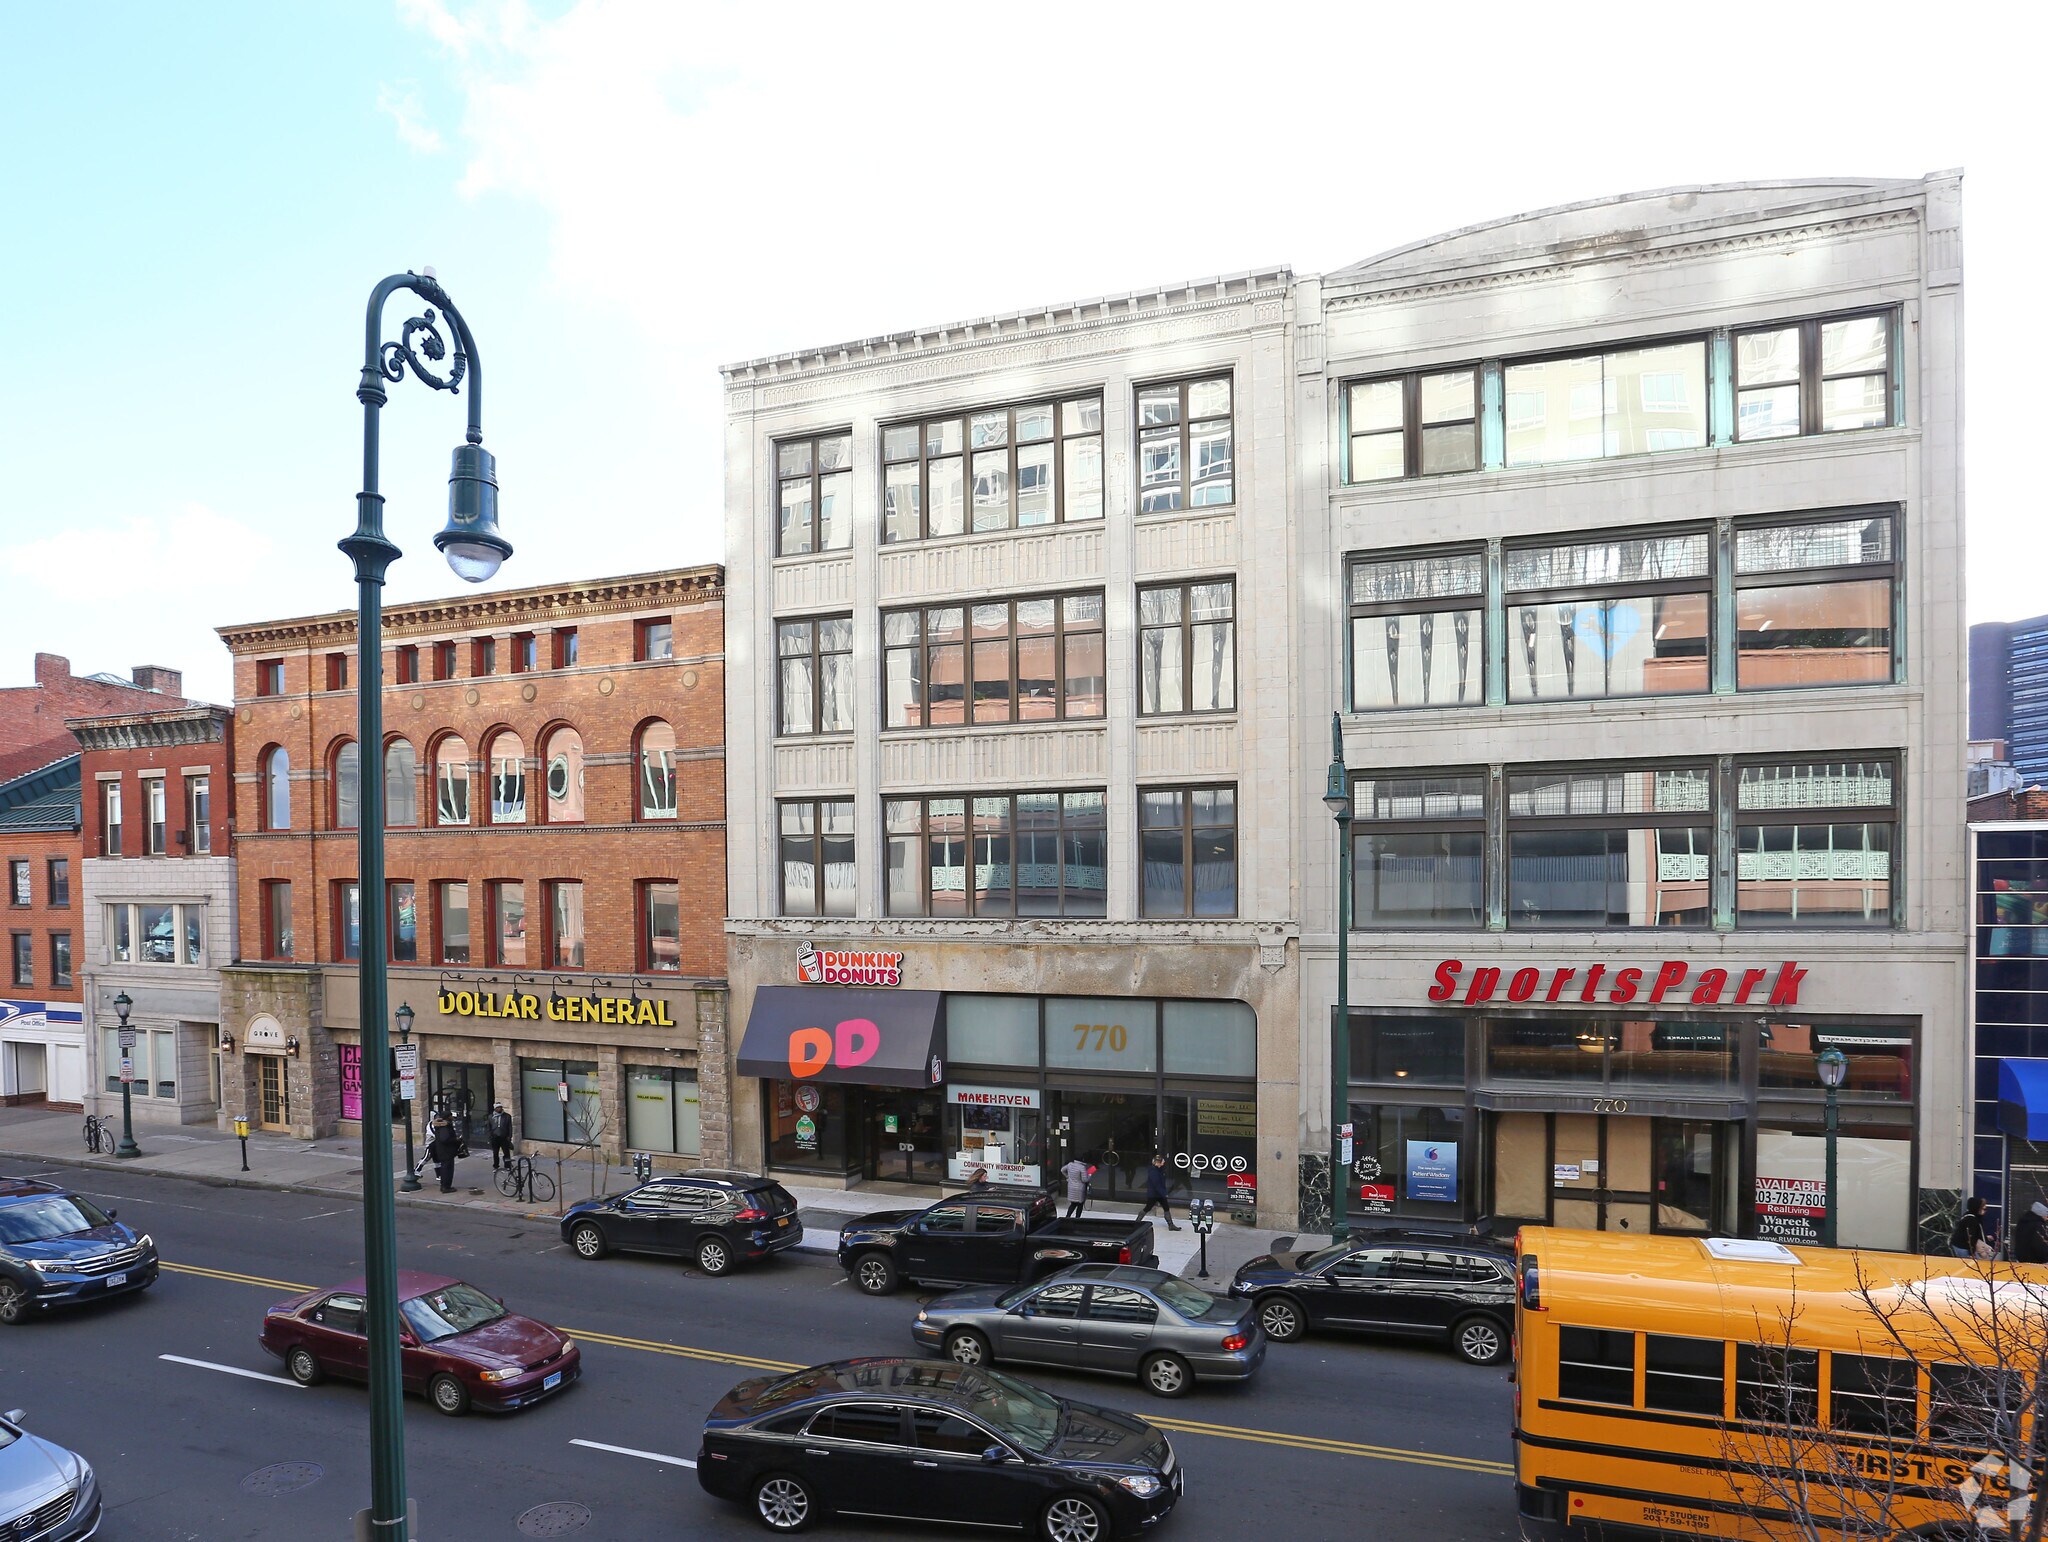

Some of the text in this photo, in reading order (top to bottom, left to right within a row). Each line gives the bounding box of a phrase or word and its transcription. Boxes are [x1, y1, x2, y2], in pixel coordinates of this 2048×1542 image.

[825, 951, 901, 968] DUNKIN'
[825, 968, 899, 985] DONUTS
[1427, 959, 1810, 1006] SportsPark
[437, 991, 674, 1026] DOLLAR GENERAL
[1073, 1024, 1128, 1052] 770
[344, 1045, 362, 1063] EL
[788, 1018, 880, 1078] DD
[957, 1092, 1031, 1106] MAKEHAVEN
[1592, 1098, 1628, 1113] 770
[963, 1160, 1026, 1172] COMMUNITY WORKSHOP
[1755, 1178, 1826, 1193] AVAILABLE
[1755, 1190, 1826, 1207] 03-787-7800
[1762, 1214, 1811, 1227] Wareck
[1759, 1224, 1817, 1237] D'Ostilio
[1757, 1235, 1819, 1245] www.RLWD.com
[1680, 1466, 1704, 1476] DIESEL
[1838, 1450, 1933, 1480] FIRST
[1643, 1507, 1710, 1522] FIRST STUDENT
[1643, 1513, 1710, 1529] 203-759-1399
